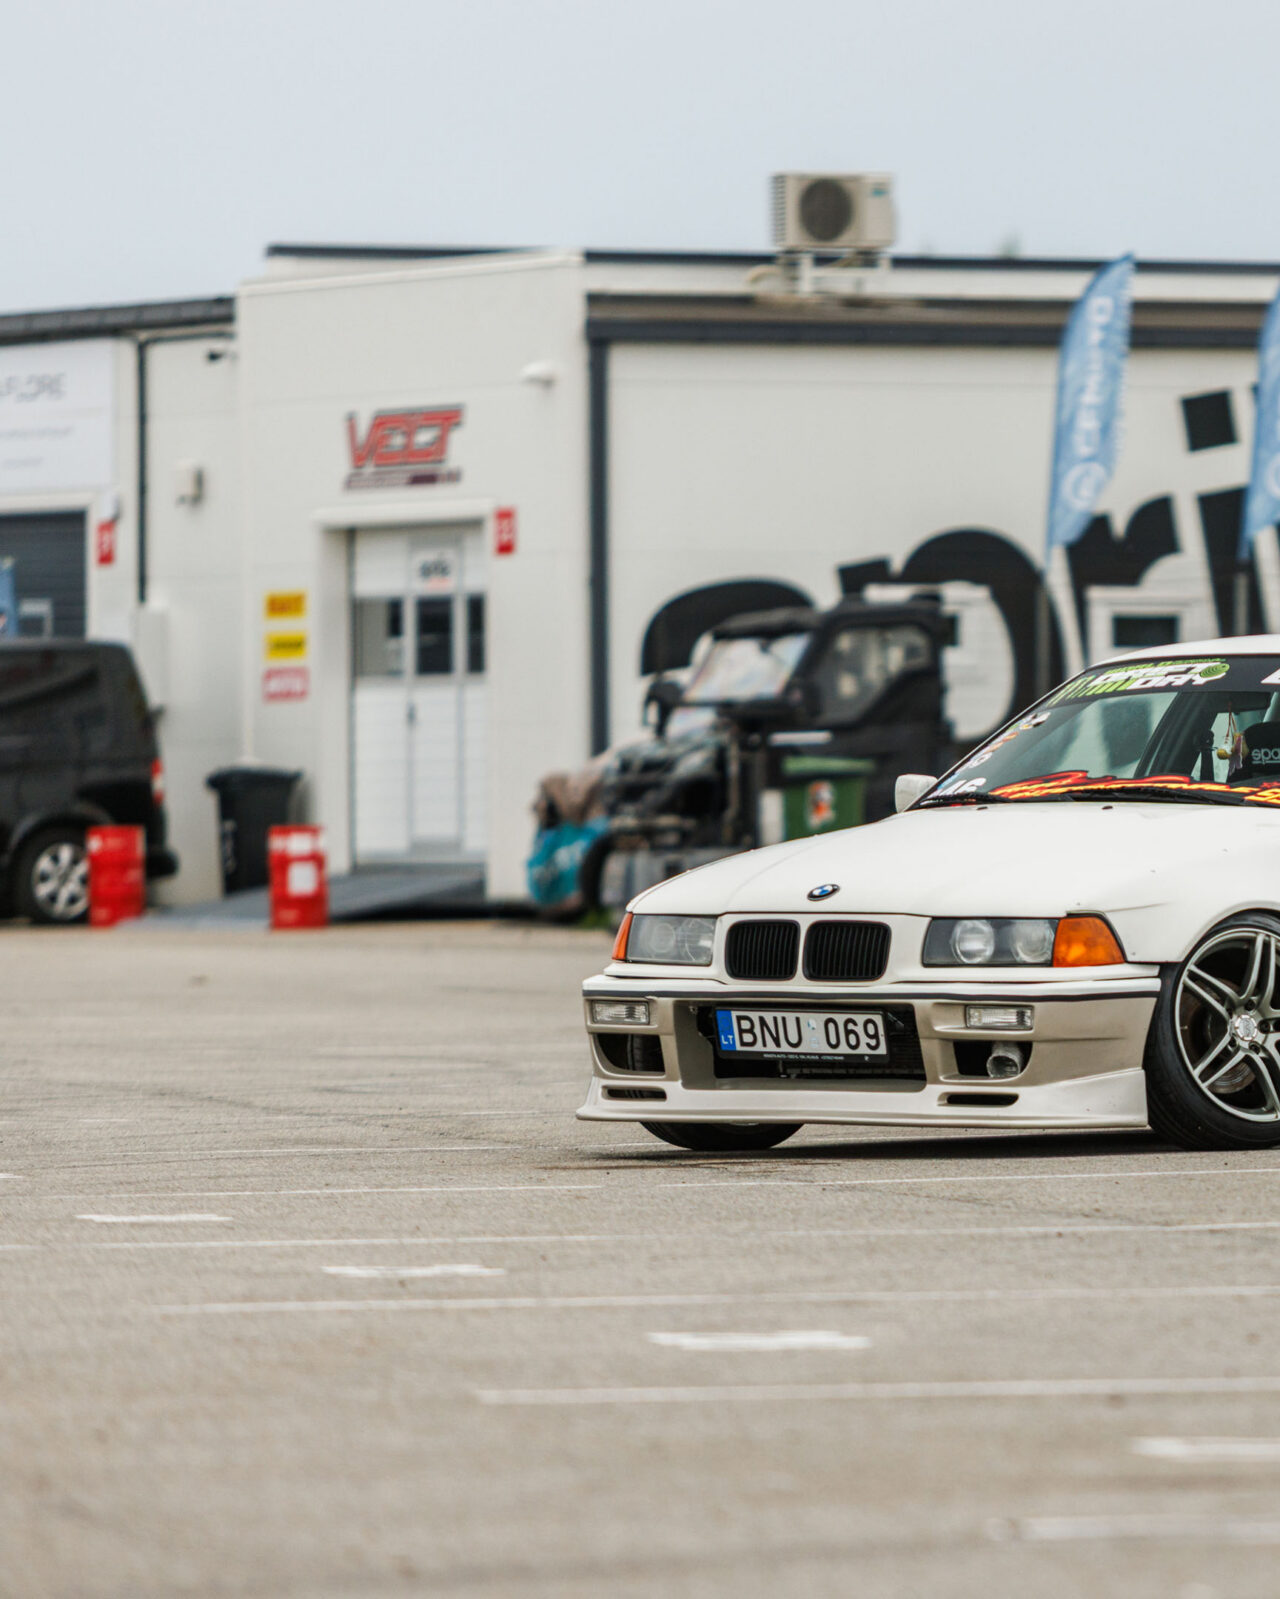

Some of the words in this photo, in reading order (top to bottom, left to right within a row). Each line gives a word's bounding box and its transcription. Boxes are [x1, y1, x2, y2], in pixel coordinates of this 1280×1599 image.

[721, 1035, 734, 1045] LT
[736, 1014, 803, 1049] BNU
[823, 1017, 881, 1051] 069
